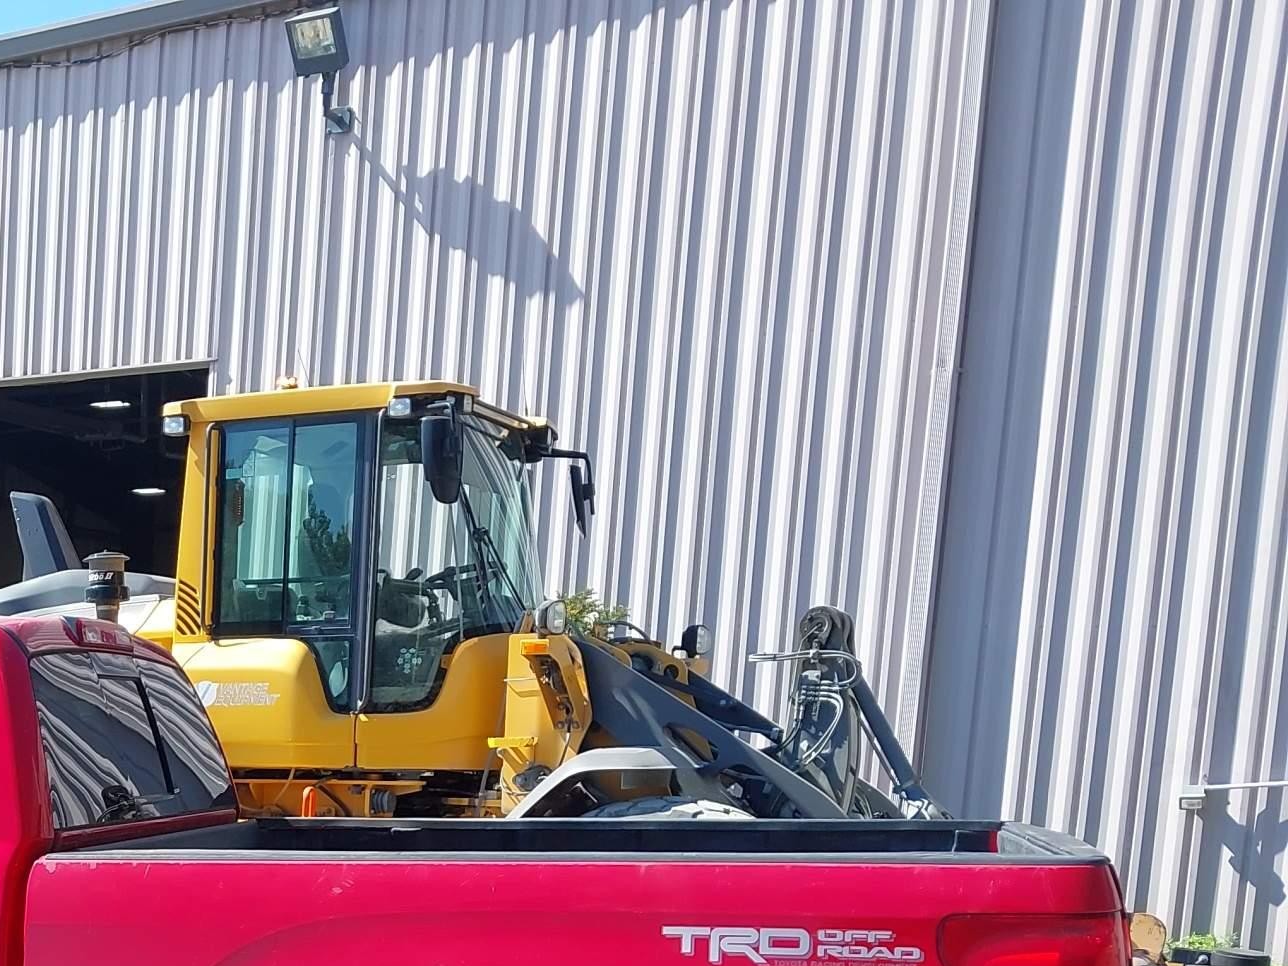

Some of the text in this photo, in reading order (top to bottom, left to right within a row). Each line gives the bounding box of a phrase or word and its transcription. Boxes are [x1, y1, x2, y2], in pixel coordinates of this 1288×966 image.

[817, 929, 896, 945] OFF
[662, 926, 813, 966] TRD
[817, 945, 925, 962] ROAD
